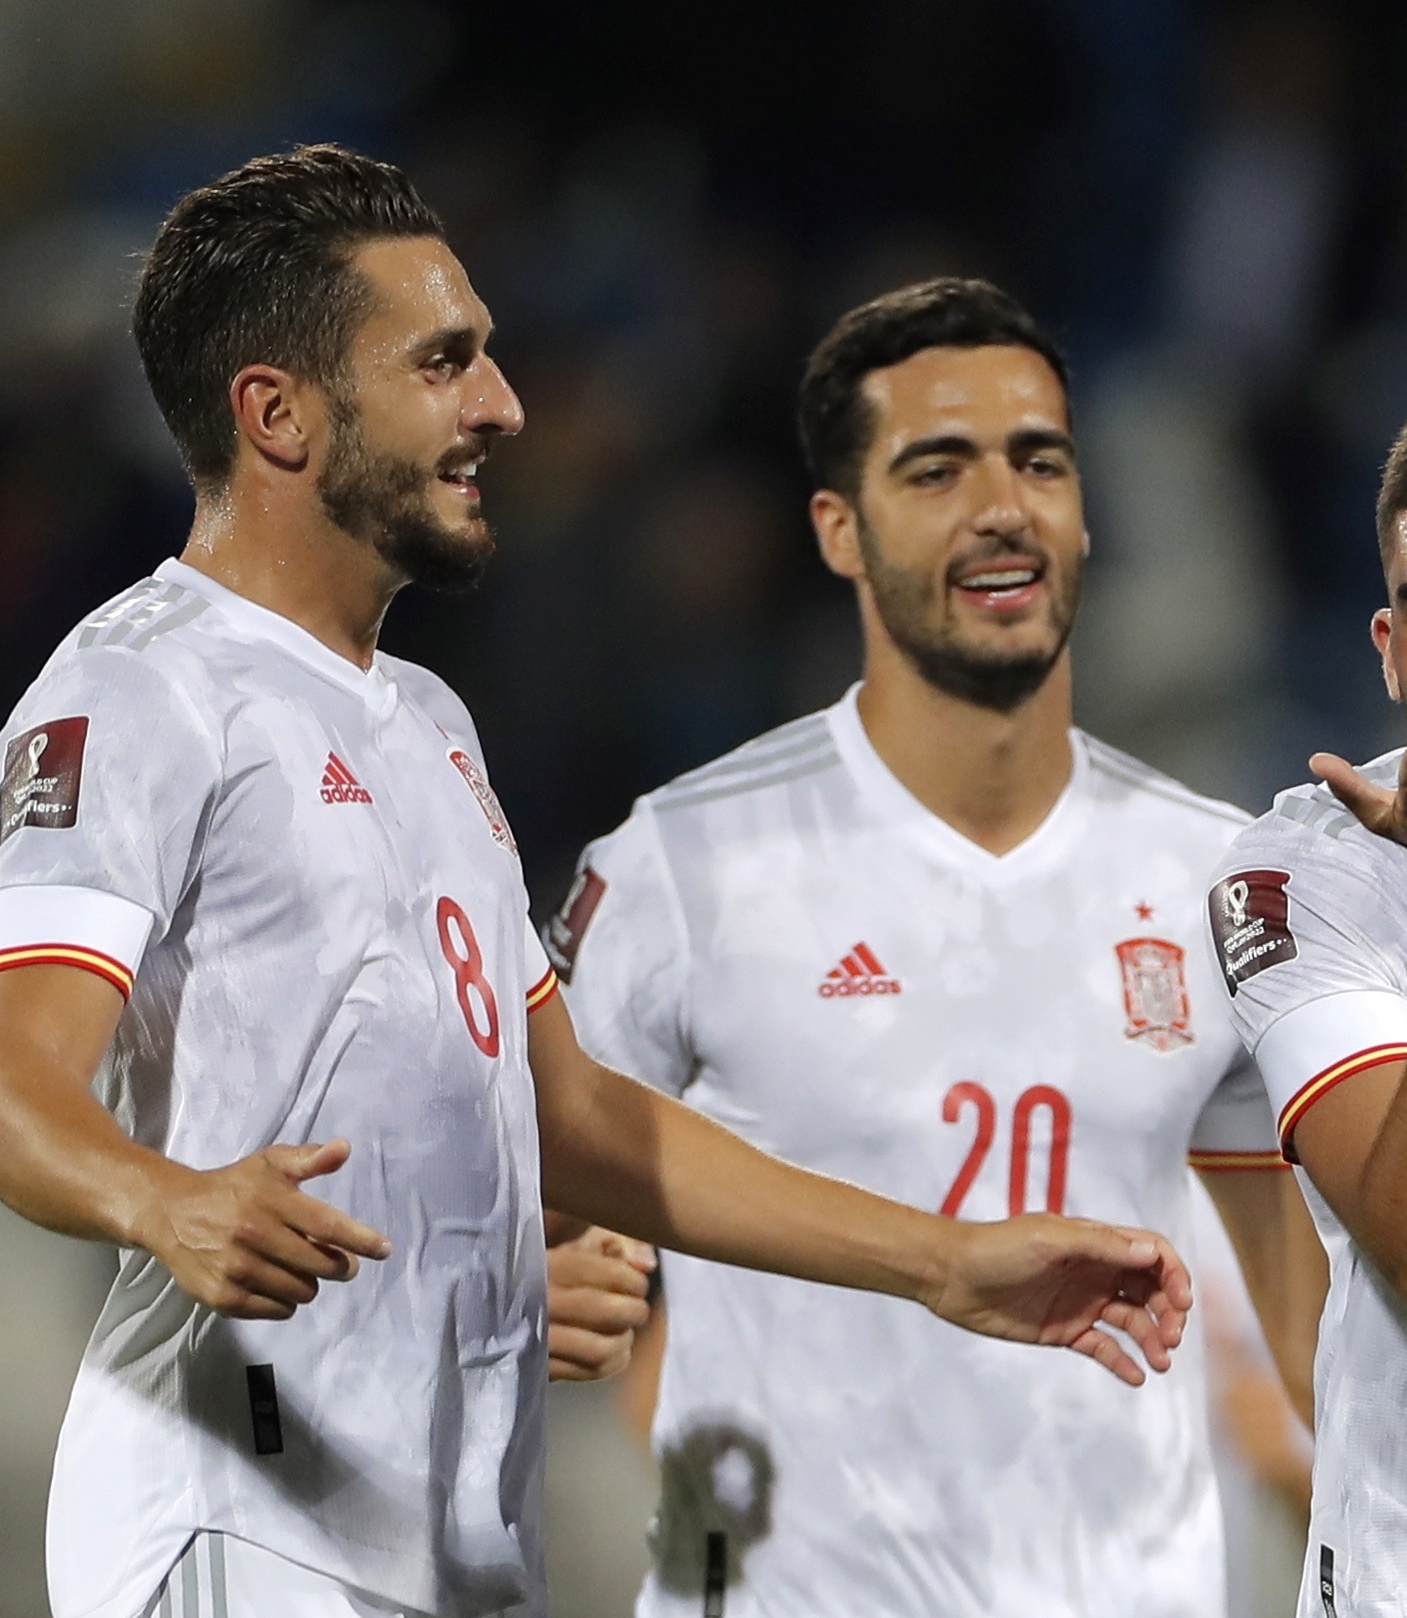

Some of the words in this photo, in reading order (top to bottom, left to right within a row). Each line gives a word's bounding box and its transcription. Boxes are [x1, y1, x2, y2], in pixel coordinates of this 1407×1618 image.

[437, 895, 500, 1059] 8
[817, 976, 902, 999] adidas
[939, 1081, 1071, 1218] 20
